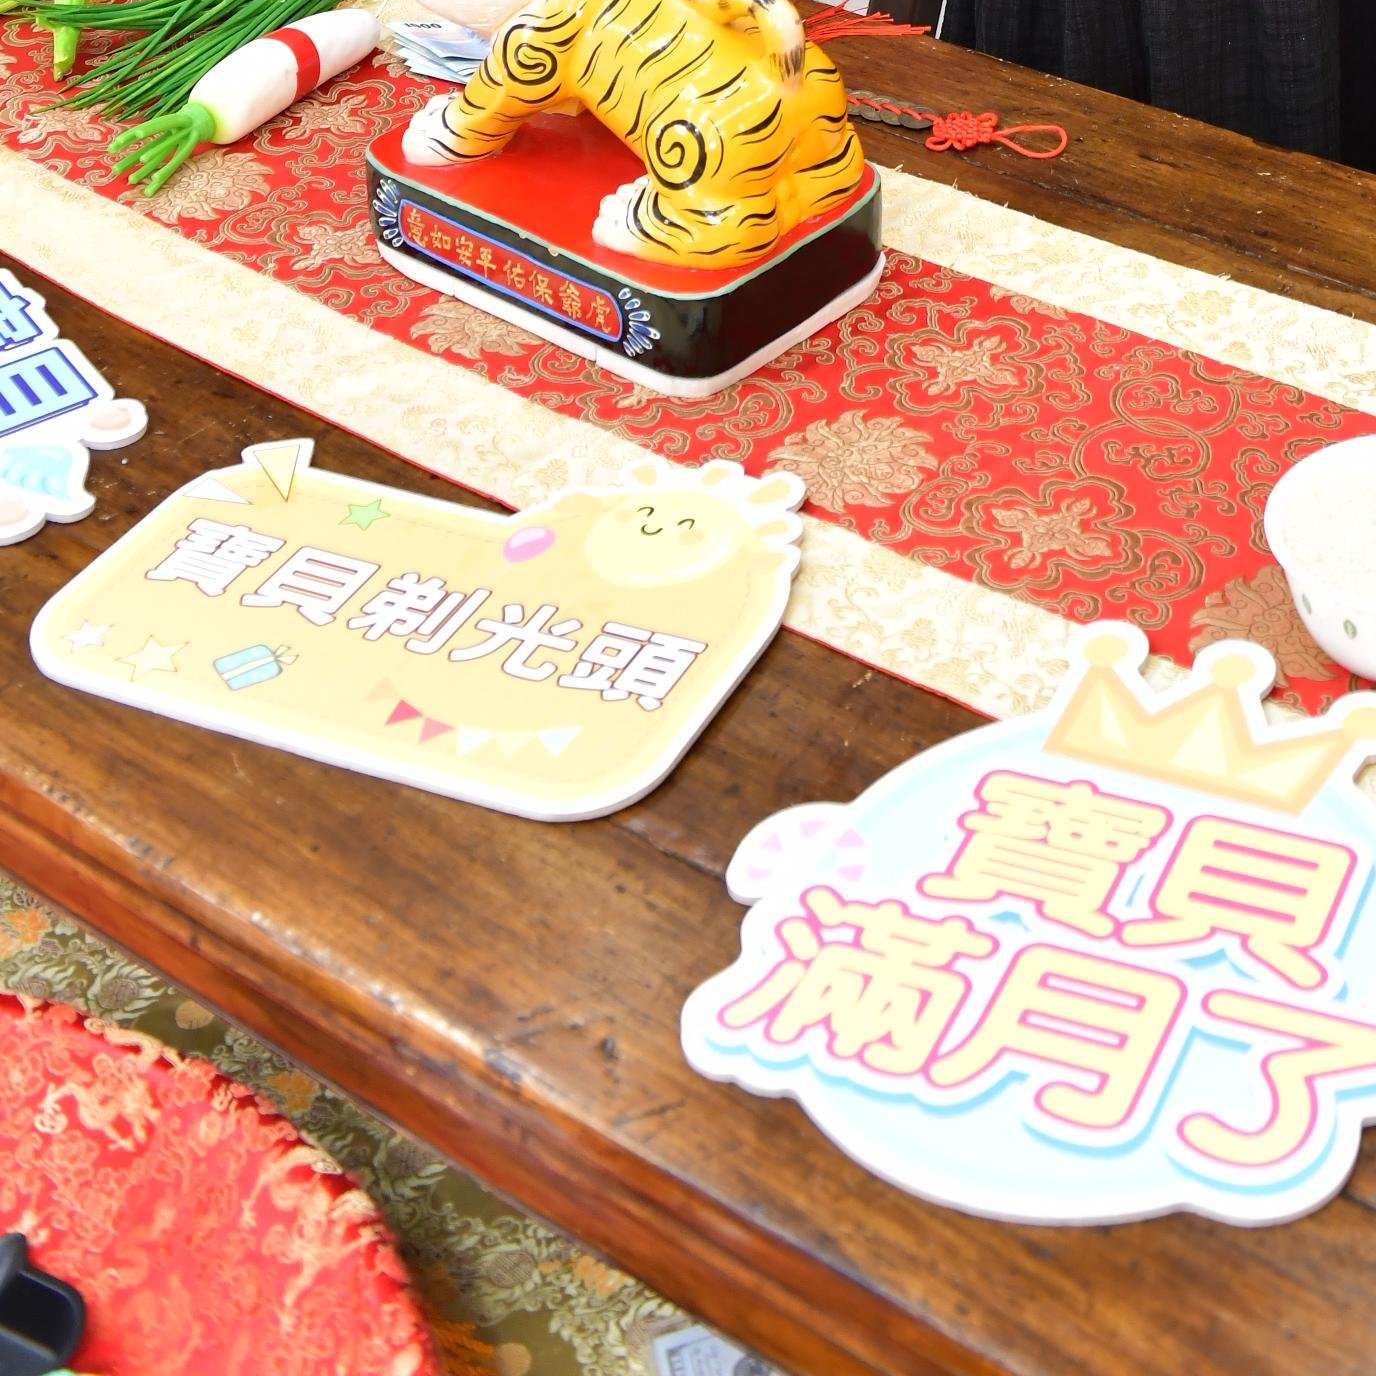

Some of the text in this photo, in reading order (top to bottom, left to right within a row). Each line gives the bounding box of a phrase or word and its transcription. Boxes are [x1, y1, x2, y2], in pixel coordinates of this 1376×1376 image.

[145, 517, 708, 712] 寶貝剃光頭
[916, 769, 1357, 990] 寶貝
